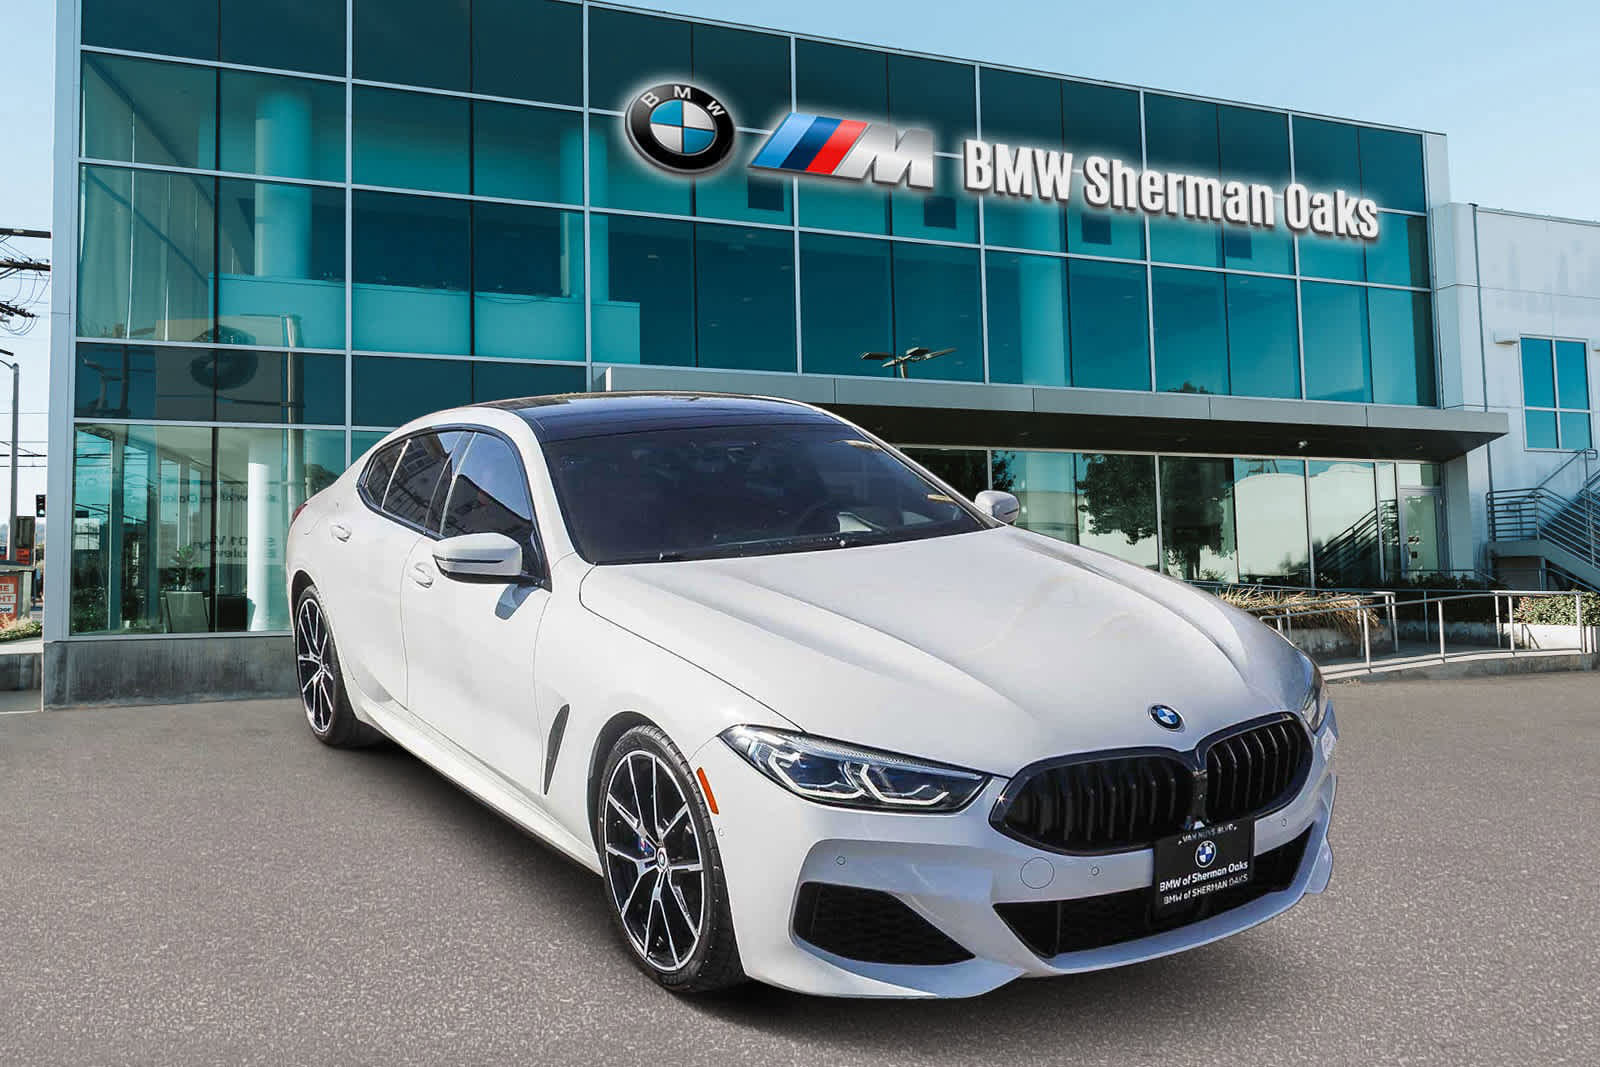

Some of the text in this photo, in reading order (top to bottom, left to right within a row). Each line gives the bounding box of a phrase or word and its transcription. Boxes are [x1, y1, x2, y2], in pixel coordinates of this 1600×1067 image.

[639, 84, 726, 118] BMW
[963, 138, 1379, 242] BMW Sherman Oaks
[1160, 860, 1249, 892] BMW of Sherman Oaks
[1163, 892, 1183, 905] BMW
[1184, 890, 1191, 899] of
[1192, 880, 1228, 897] SHERMAN
